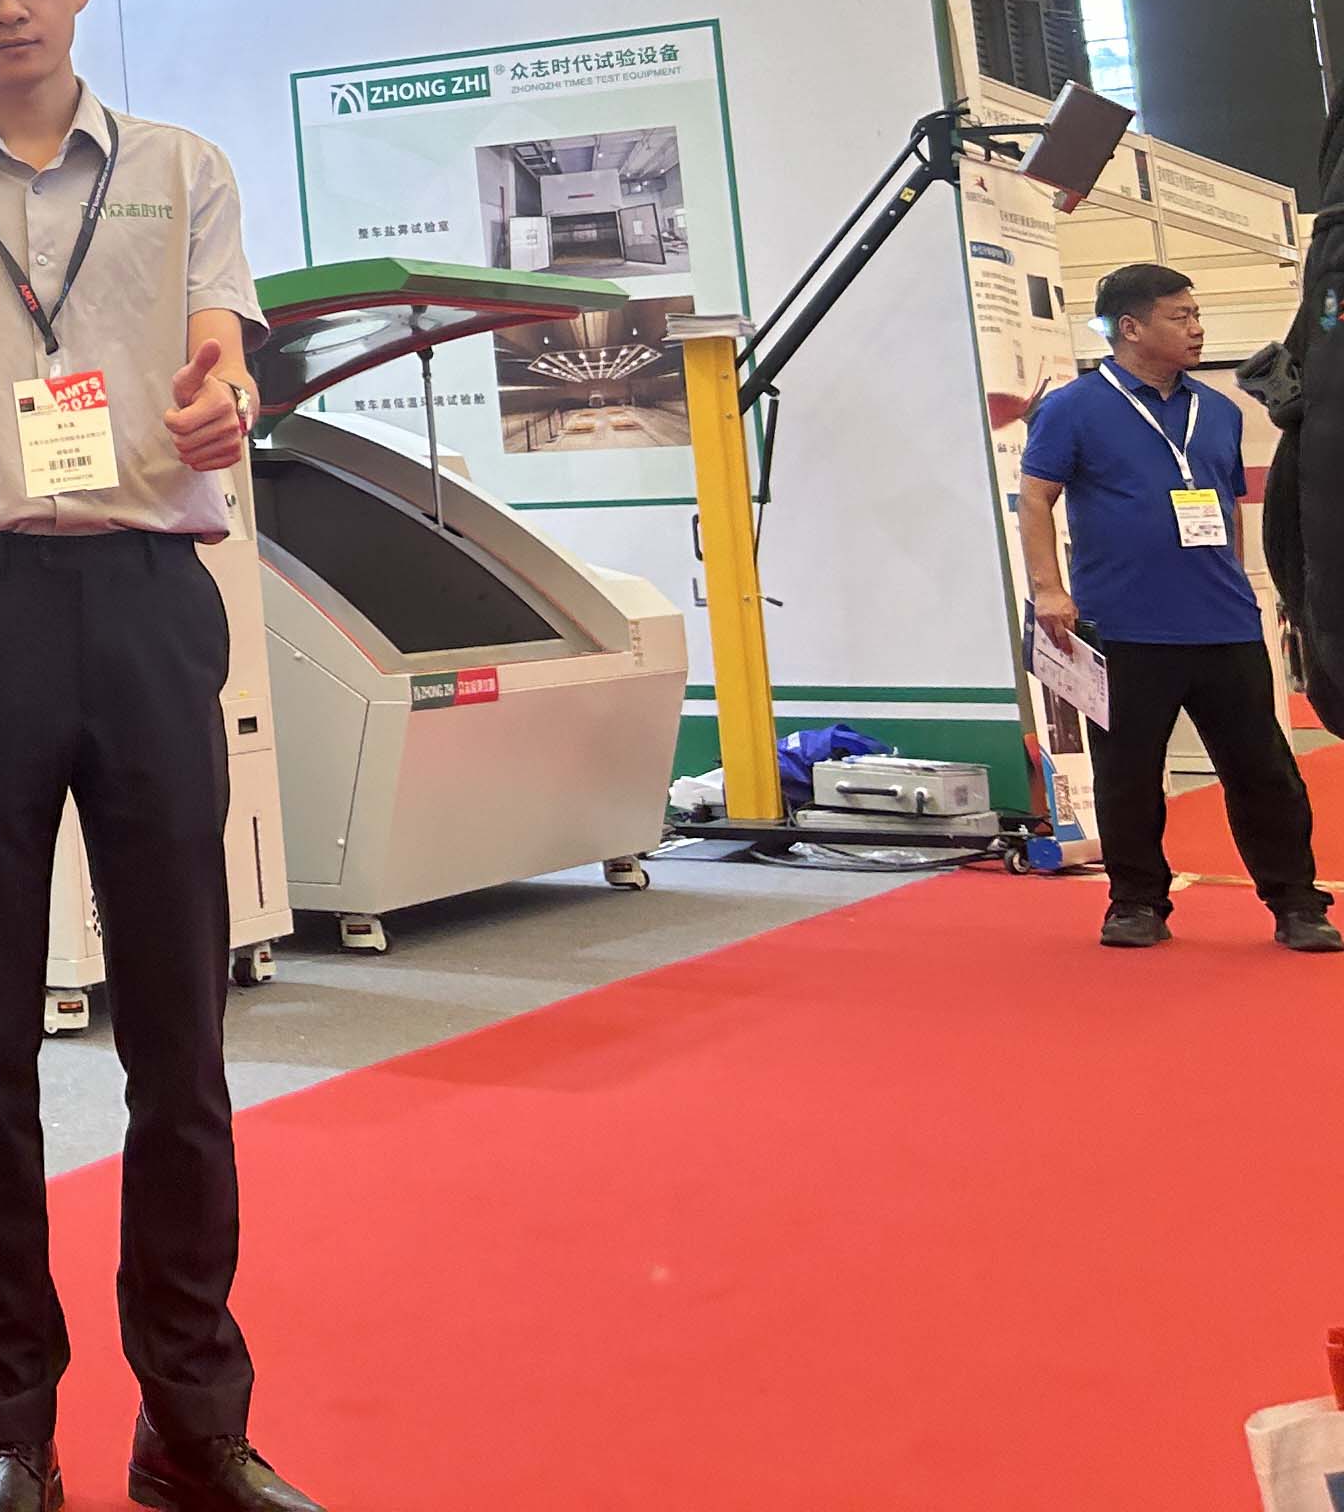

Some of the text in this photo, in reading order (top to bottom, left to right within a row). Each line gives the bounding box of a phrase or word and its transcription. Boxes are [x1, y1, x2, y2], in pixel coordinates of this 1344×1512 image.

[510, 44, 681, 81] 众志时代试验设备
[370, 74, 488, 104] ZHONG ZHI
[564, 74, 593, 88] TIMES
[596, 71, 620, 85] TEST
[623, 65, 682, 82] EQUIPMENT
[55, 376, 101, 402] AMTS
[60, 390, 107, 413] 2024
